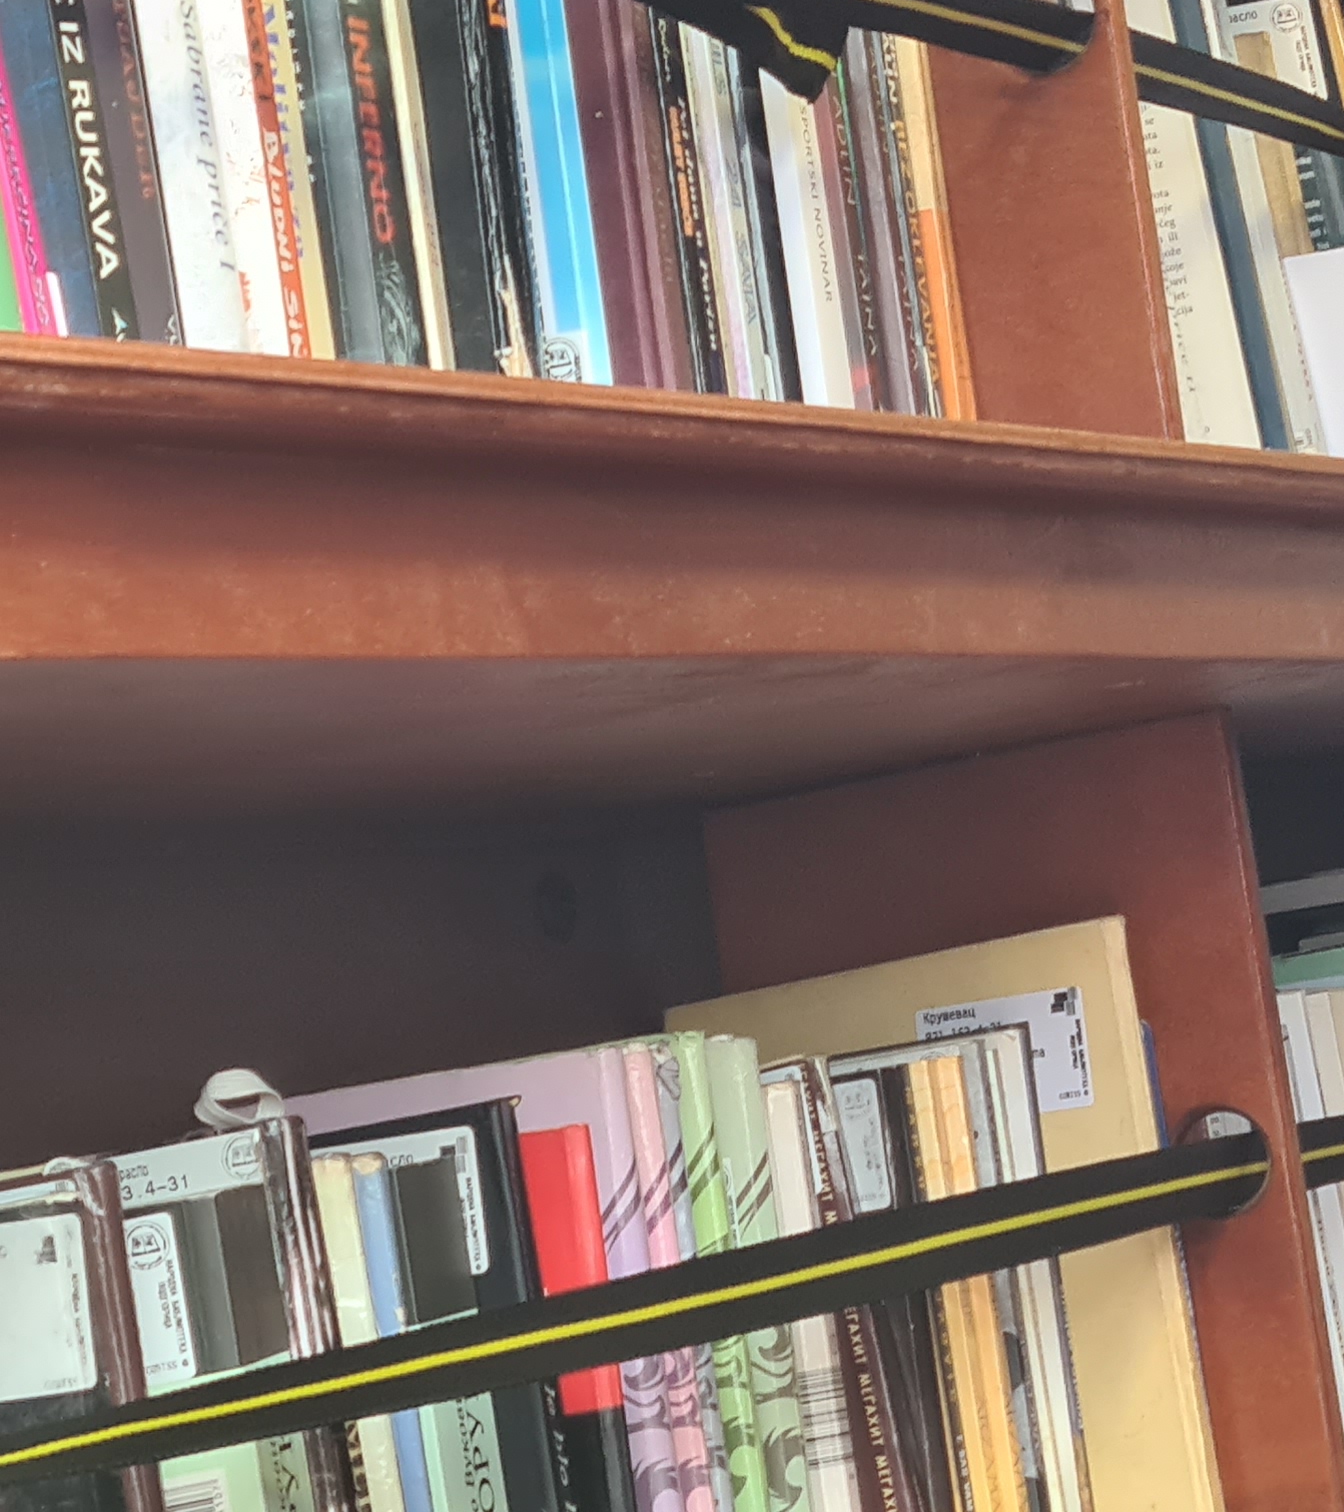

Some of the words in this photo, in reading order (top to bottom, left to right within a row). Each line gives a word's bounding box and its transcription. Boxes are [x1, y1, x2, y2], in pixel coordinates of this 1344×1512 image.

[58, 21, 85, 65] IZ
[179, 0, 211, 148] Sabrane
[197, 155, 229, 248] price
[347, 15, 394, 244] INFERNO
[68, 79, 119, 280] RUKAVA
[799, 105, 819, 203] SPORTSKI
[813, 207, 833, 304] NOVINAR
[922, 1008, 976, 1026] Крушевац
[119, 1164, 150, 1181] расло
[122, 1174, 190, 1201] 3.4-31
[844, 1307, 867, 1367] ЕГАХИТ
[859, 1372, 886, 1448] МЕГАХИТ
[874, 1454, 898, 1512] МЕГАХ
